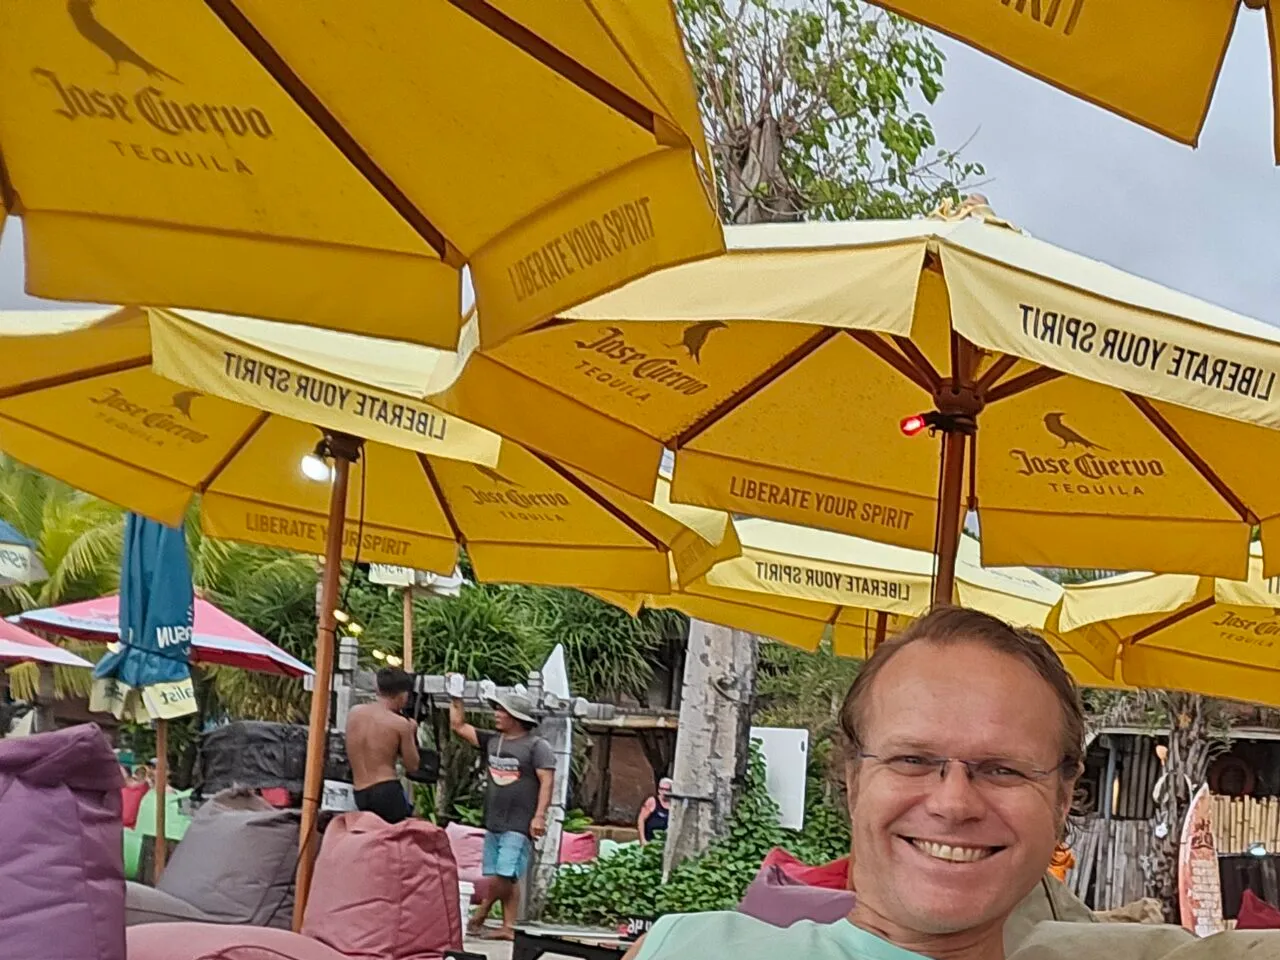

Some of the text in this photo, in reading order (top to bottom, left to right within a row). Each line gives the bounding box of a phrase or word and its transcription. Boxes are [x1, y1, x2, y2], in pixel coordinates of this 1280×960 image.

[30, 66, 274, 146] Jose Cuervo
[108, 140, 253, 175] TEQUILA
[507, 196, 655, 301] LIBERATE YOUR SPIRIT
[574, 326, 709, 396] Jose Cuervo
[574, 360, 651, 402] TEQUILA
[1009, 449, 1167, 480] Jose Cuervo
[730, 476, 914, 530] LIBERATE YOUR SPIRIT
[1048, 482, 1144, 495] TEQUILA
[245, 512, 412, 556] LIBERATE YUR SPIRIT
